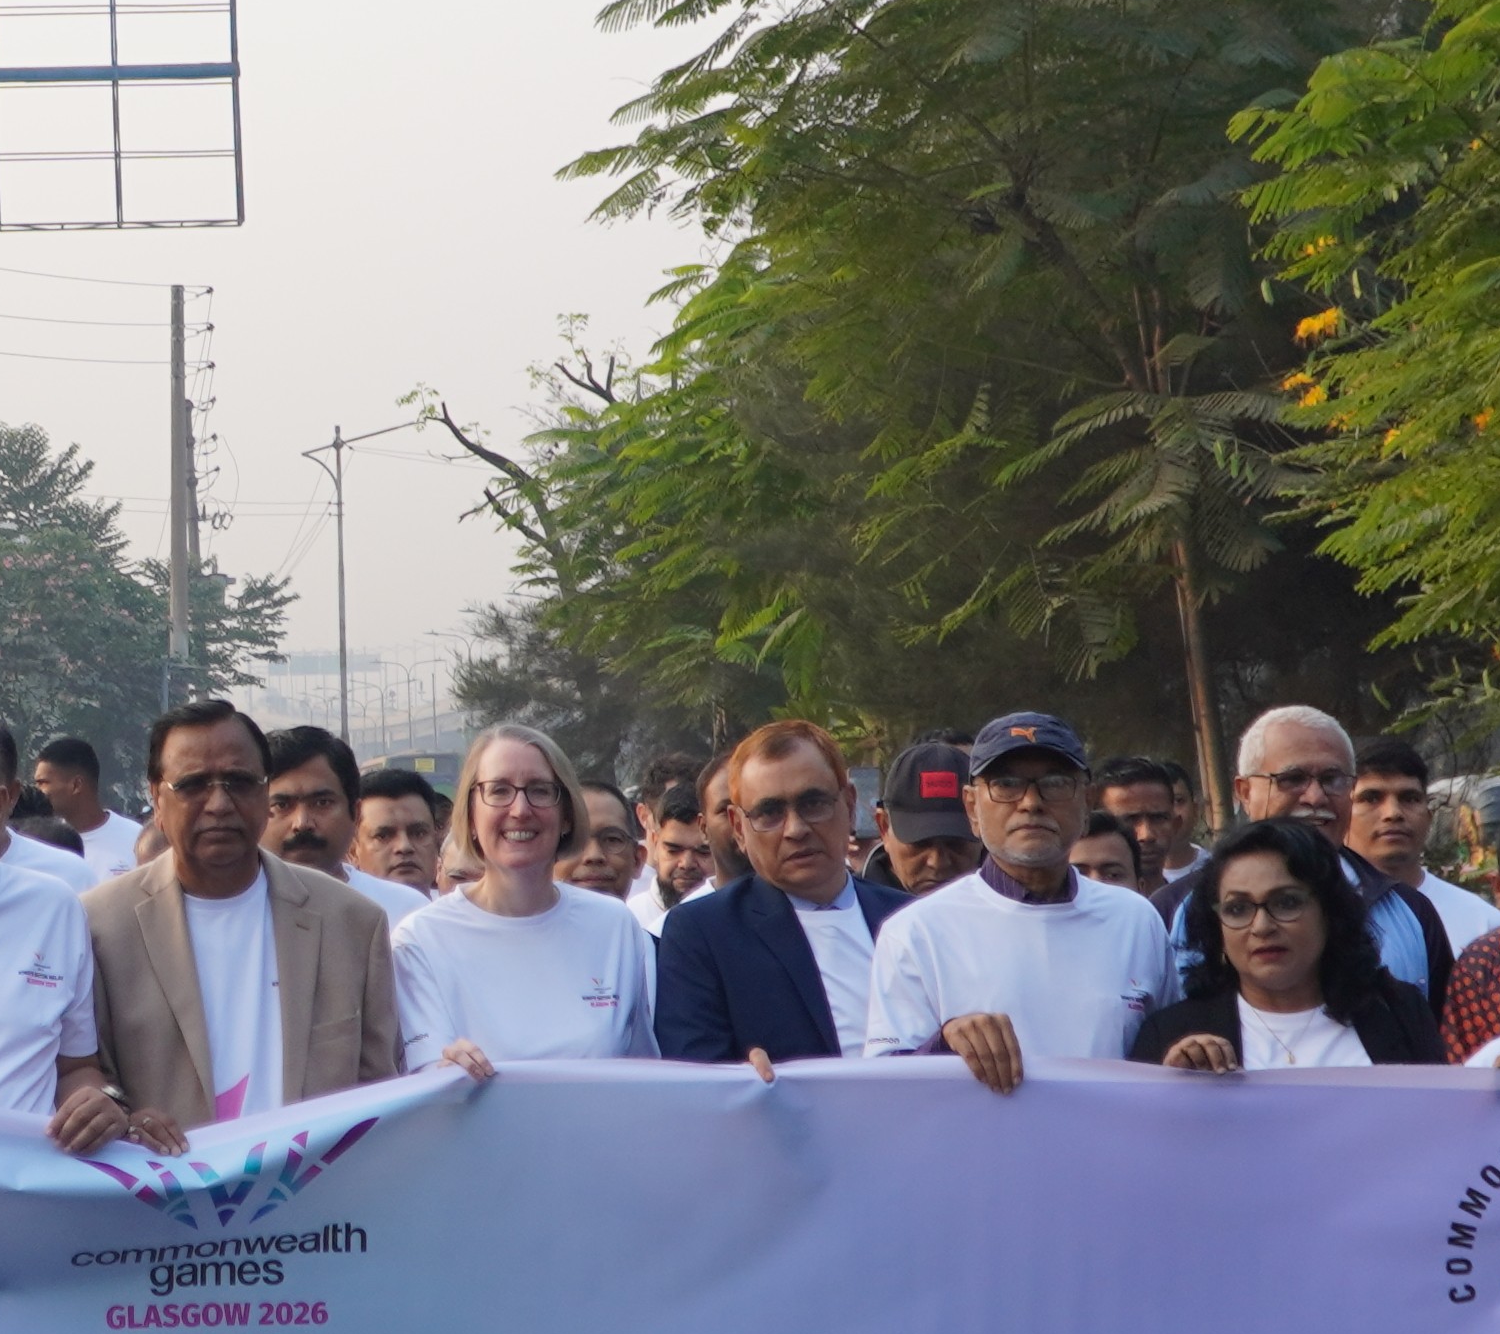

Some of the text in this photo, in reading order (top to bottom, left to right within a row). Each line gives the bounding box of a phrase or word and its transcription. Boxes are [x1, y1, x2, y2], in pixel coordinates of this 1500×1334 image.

[71, 1222, 367, 1267] commonwealth
[150, 1259, 284, 1296] games
[106, 1302, 329, 1329] GLASGOW 2026
